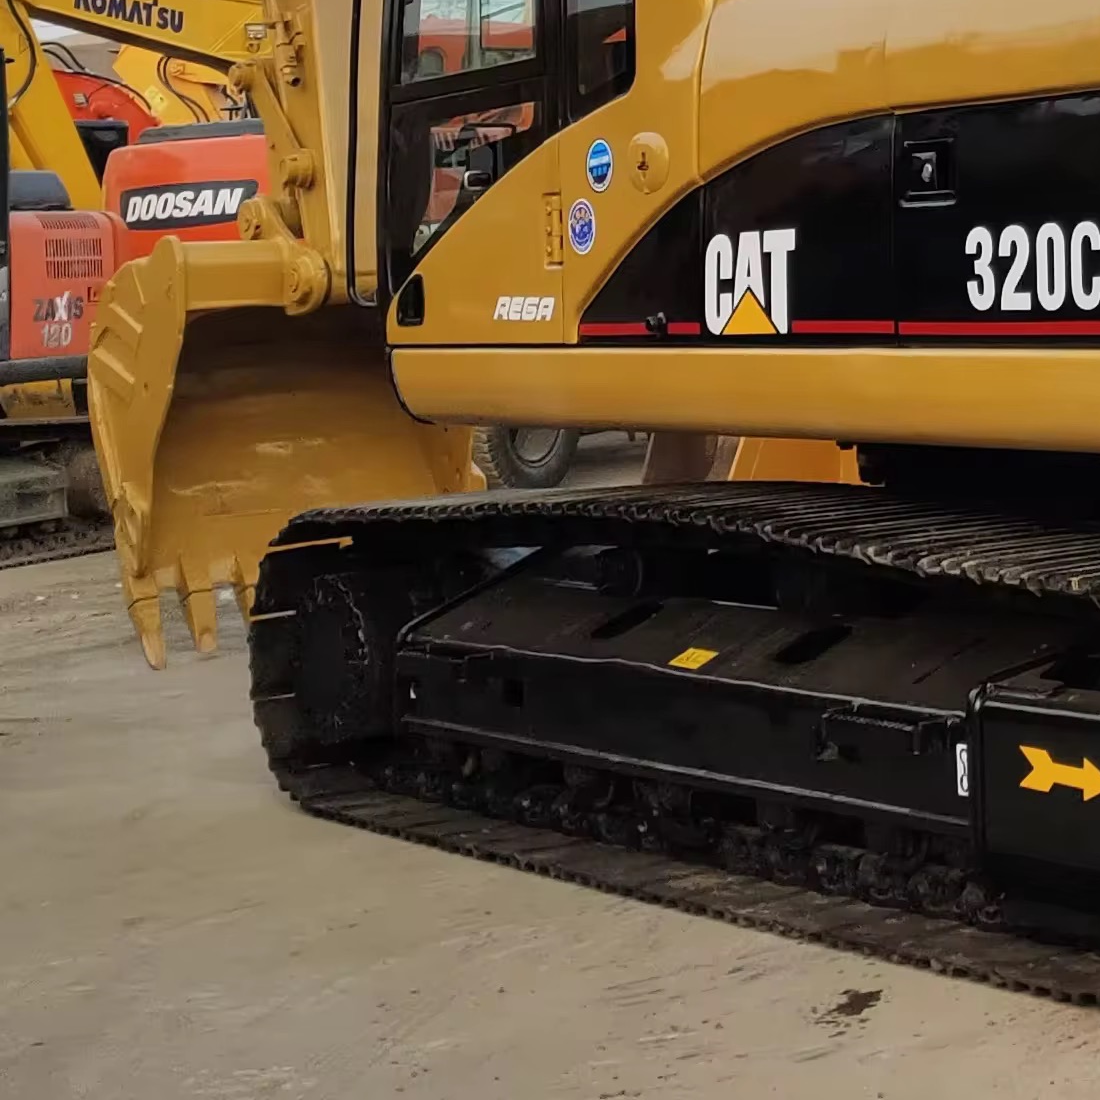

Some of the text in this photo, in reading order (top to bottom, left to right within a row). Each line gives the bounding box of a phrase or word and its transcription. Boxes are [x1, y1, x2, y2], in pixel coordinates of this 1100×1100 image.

[126, 188, 244, 222] DOOSAN
[705, 228, 795, 335] CAT
[493, 296, 555, 321] REGA
[42, 322, 72, 348] 120
